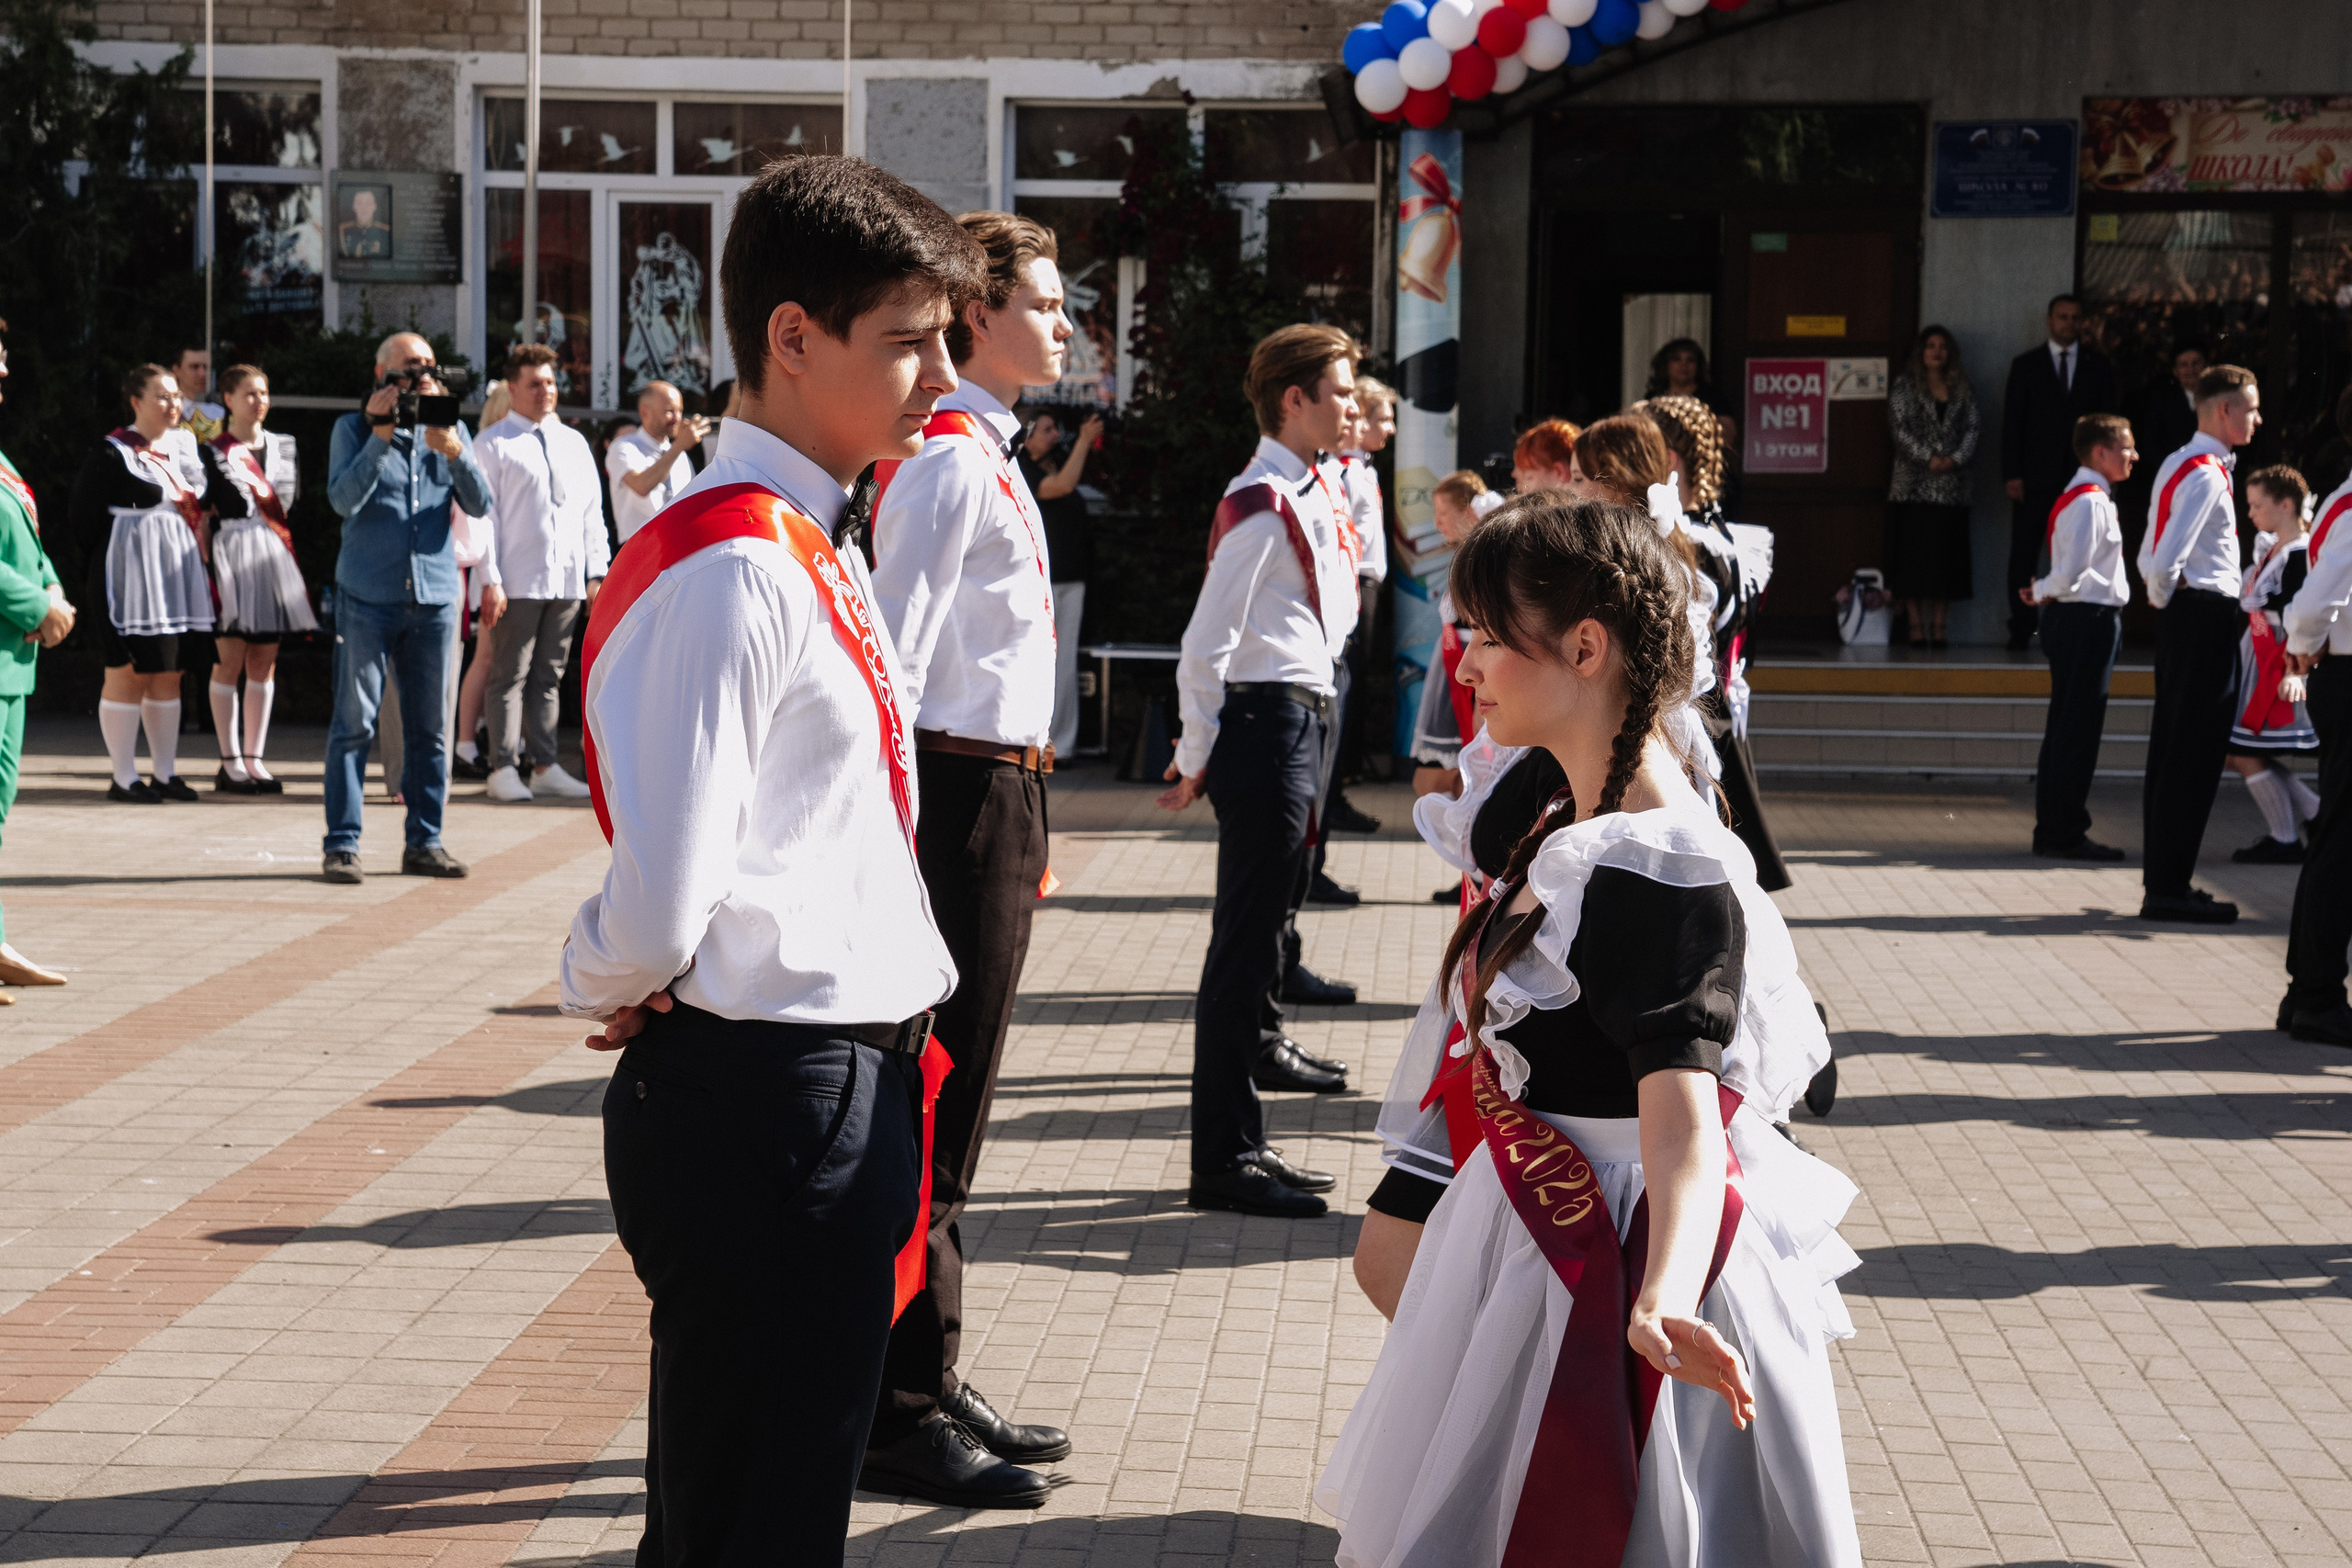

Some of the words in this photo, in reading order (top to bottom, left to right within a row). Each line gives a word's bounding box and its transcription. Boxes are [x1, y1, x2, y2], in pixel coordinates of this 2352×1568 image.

[1753, 373, 1822, 397] ВХОД
[1760, 404, 1811, 430] №1
[1765, 443, 1818, 457] этаж
[1505, 1122, 1603, 1226] 2025
